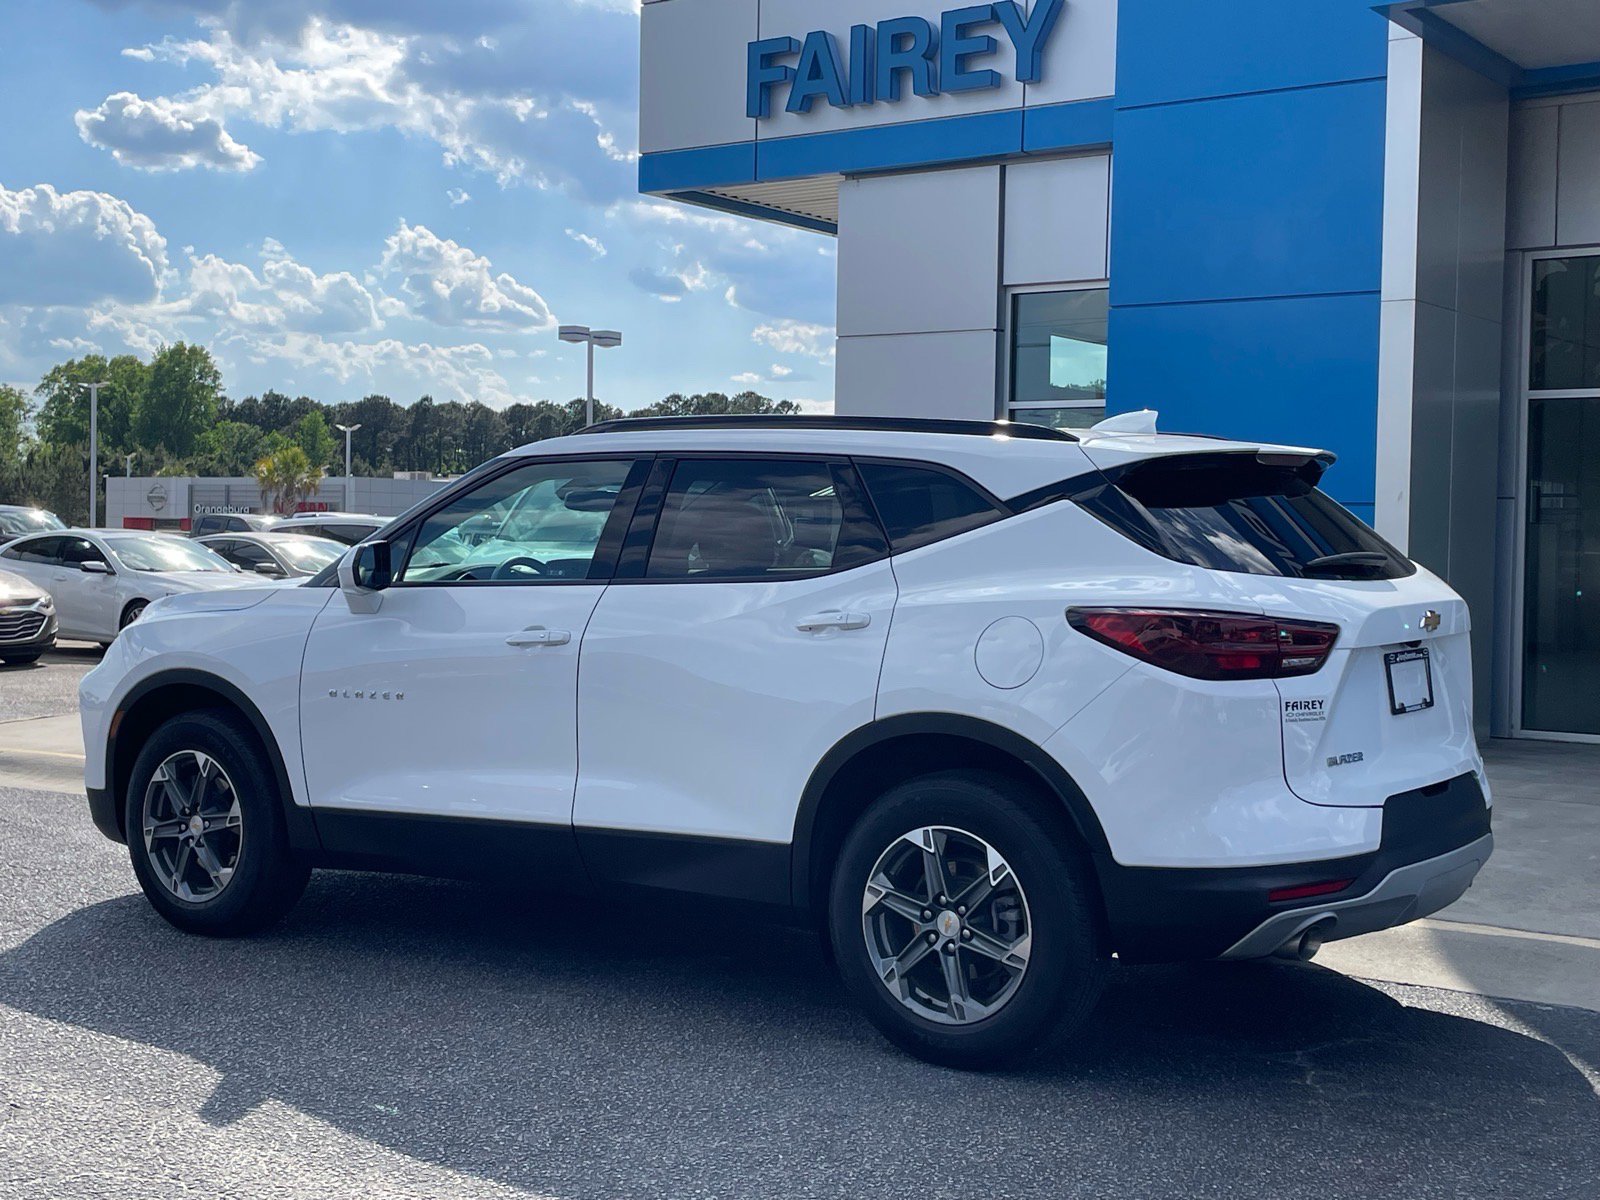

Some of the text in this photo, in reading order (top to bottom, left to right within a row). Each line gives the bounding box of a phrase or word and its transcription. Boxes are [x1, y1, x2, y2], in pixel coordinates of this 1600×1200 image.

[746, 0, 1065, 119] FAIREY
[193, 503, 250, 514] Orangeburg
[328, 688, 405, 701] BLAZER
[1285, 700, 1324, 711] FAIREY
